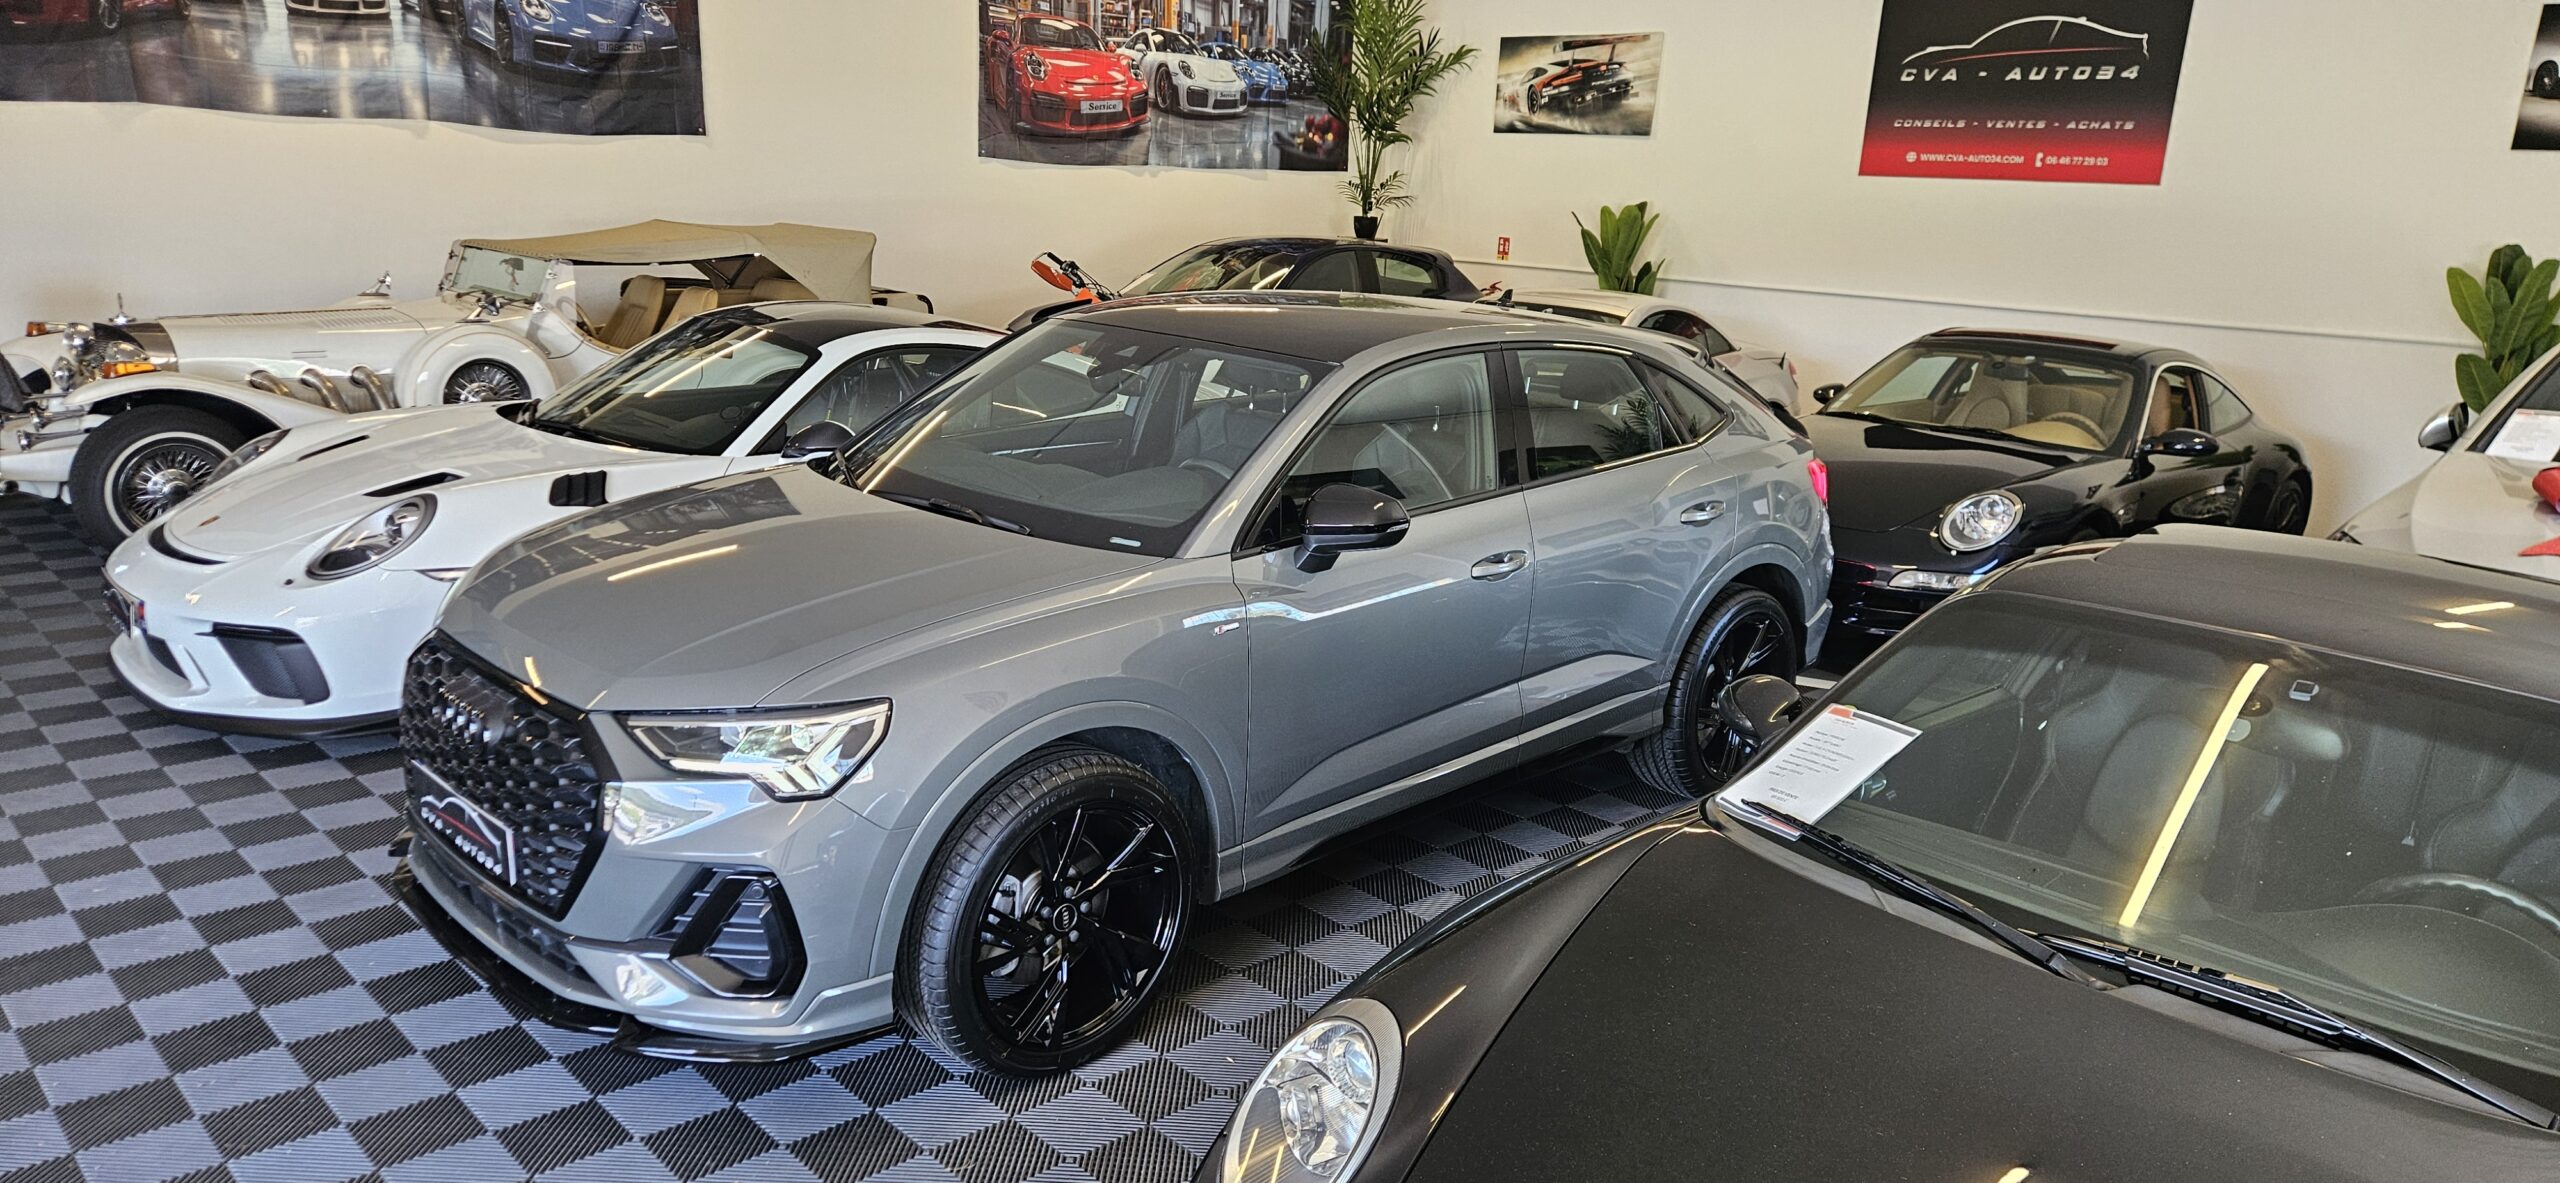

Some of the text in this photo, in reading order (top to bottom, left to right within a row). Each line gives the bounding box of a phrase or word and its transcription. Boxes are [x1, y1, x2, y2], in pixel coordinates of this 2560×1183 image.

[1900, 68, 1958, 81] CVA
[2005, 66, 2140, 81] AUTO34
[1088, 102, 1117, 111] Service
[1893, 119, 1968, 128] CONSEILS
[1986, 120, 2048, 129] VENTES
[2065, 120, 2137, 130] ACHATS
[1920, 153, 2025, 164] WWW.CVA-AUTO34.COM
